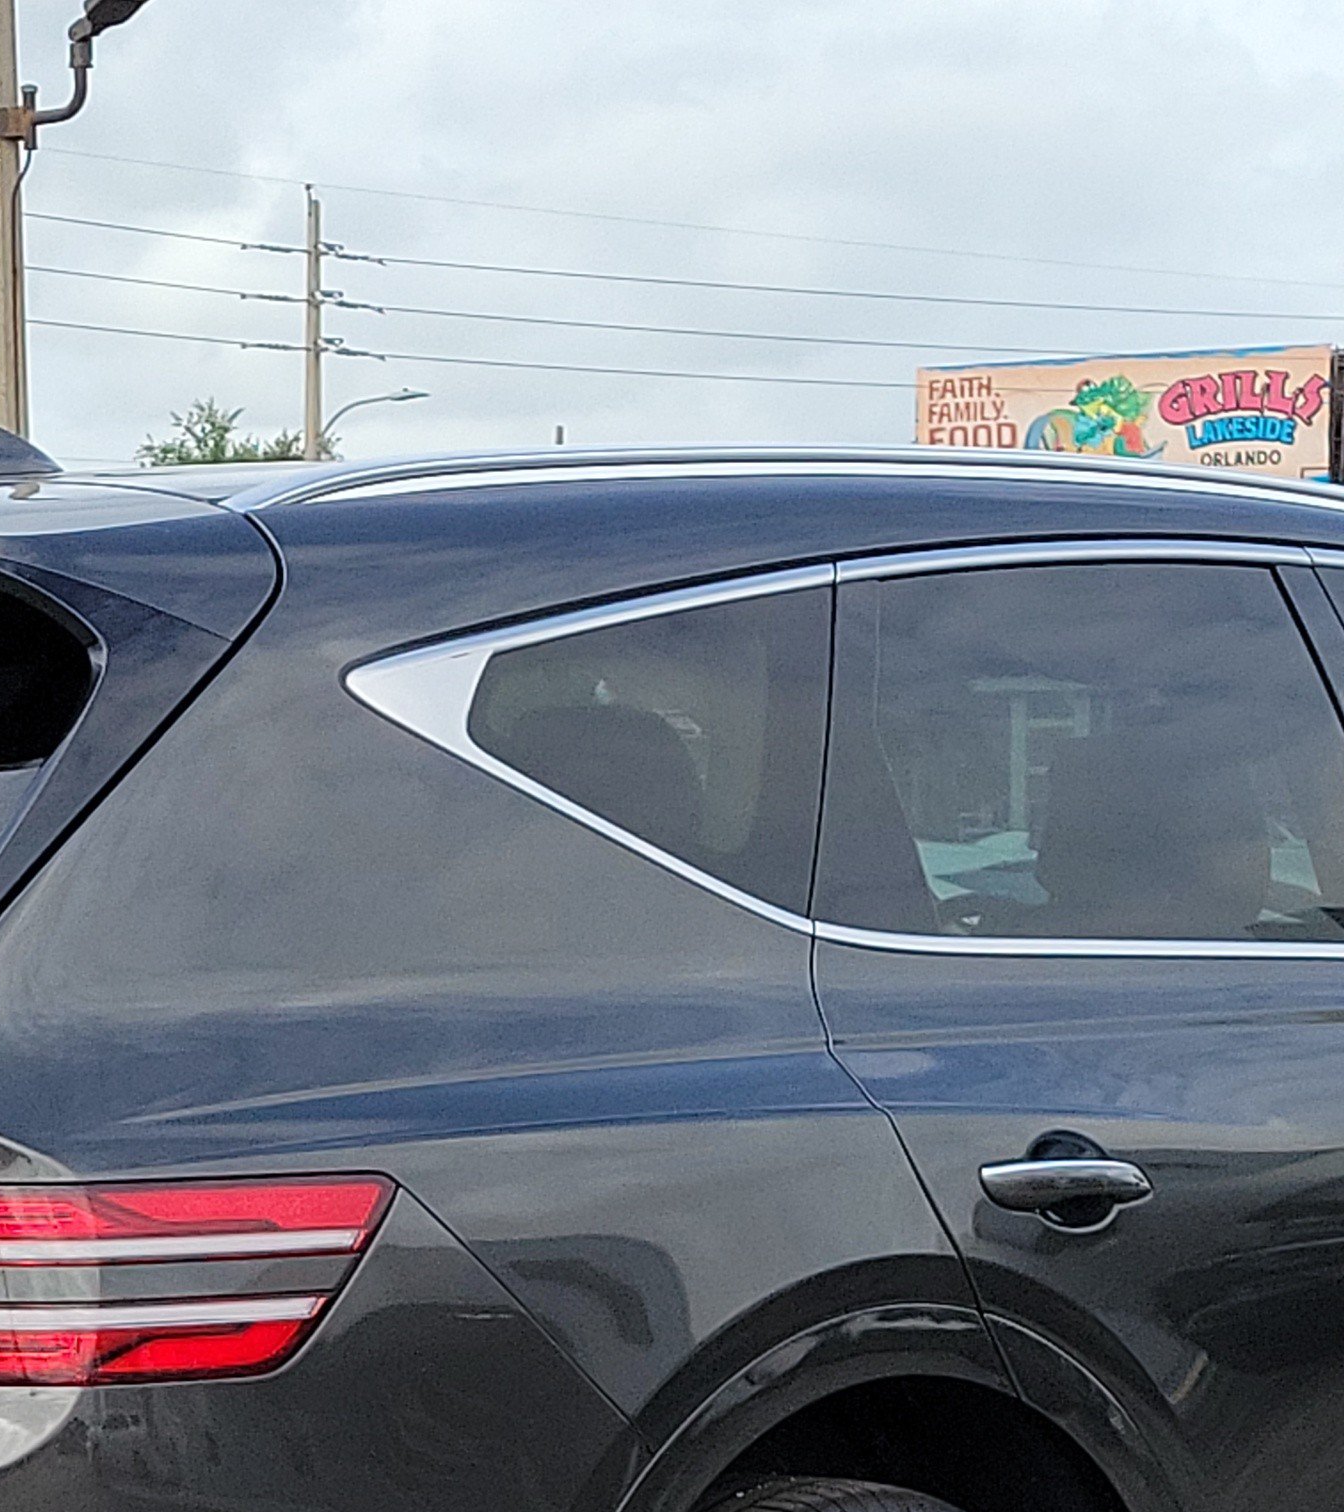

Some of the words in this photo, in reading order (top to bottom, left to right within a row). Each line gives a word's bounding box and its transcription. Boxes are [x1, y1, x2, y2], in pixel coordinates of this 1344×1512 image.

[929, 376, 1001, 400] FAITH.
[1158, 370, 1327, 426] GRILLS
[928, 400, 1008, 423] FAMILY.
[1186, 416, 1297, 449] LAKESIDE
[1200, 449, 1281, 466] ORLANDO
